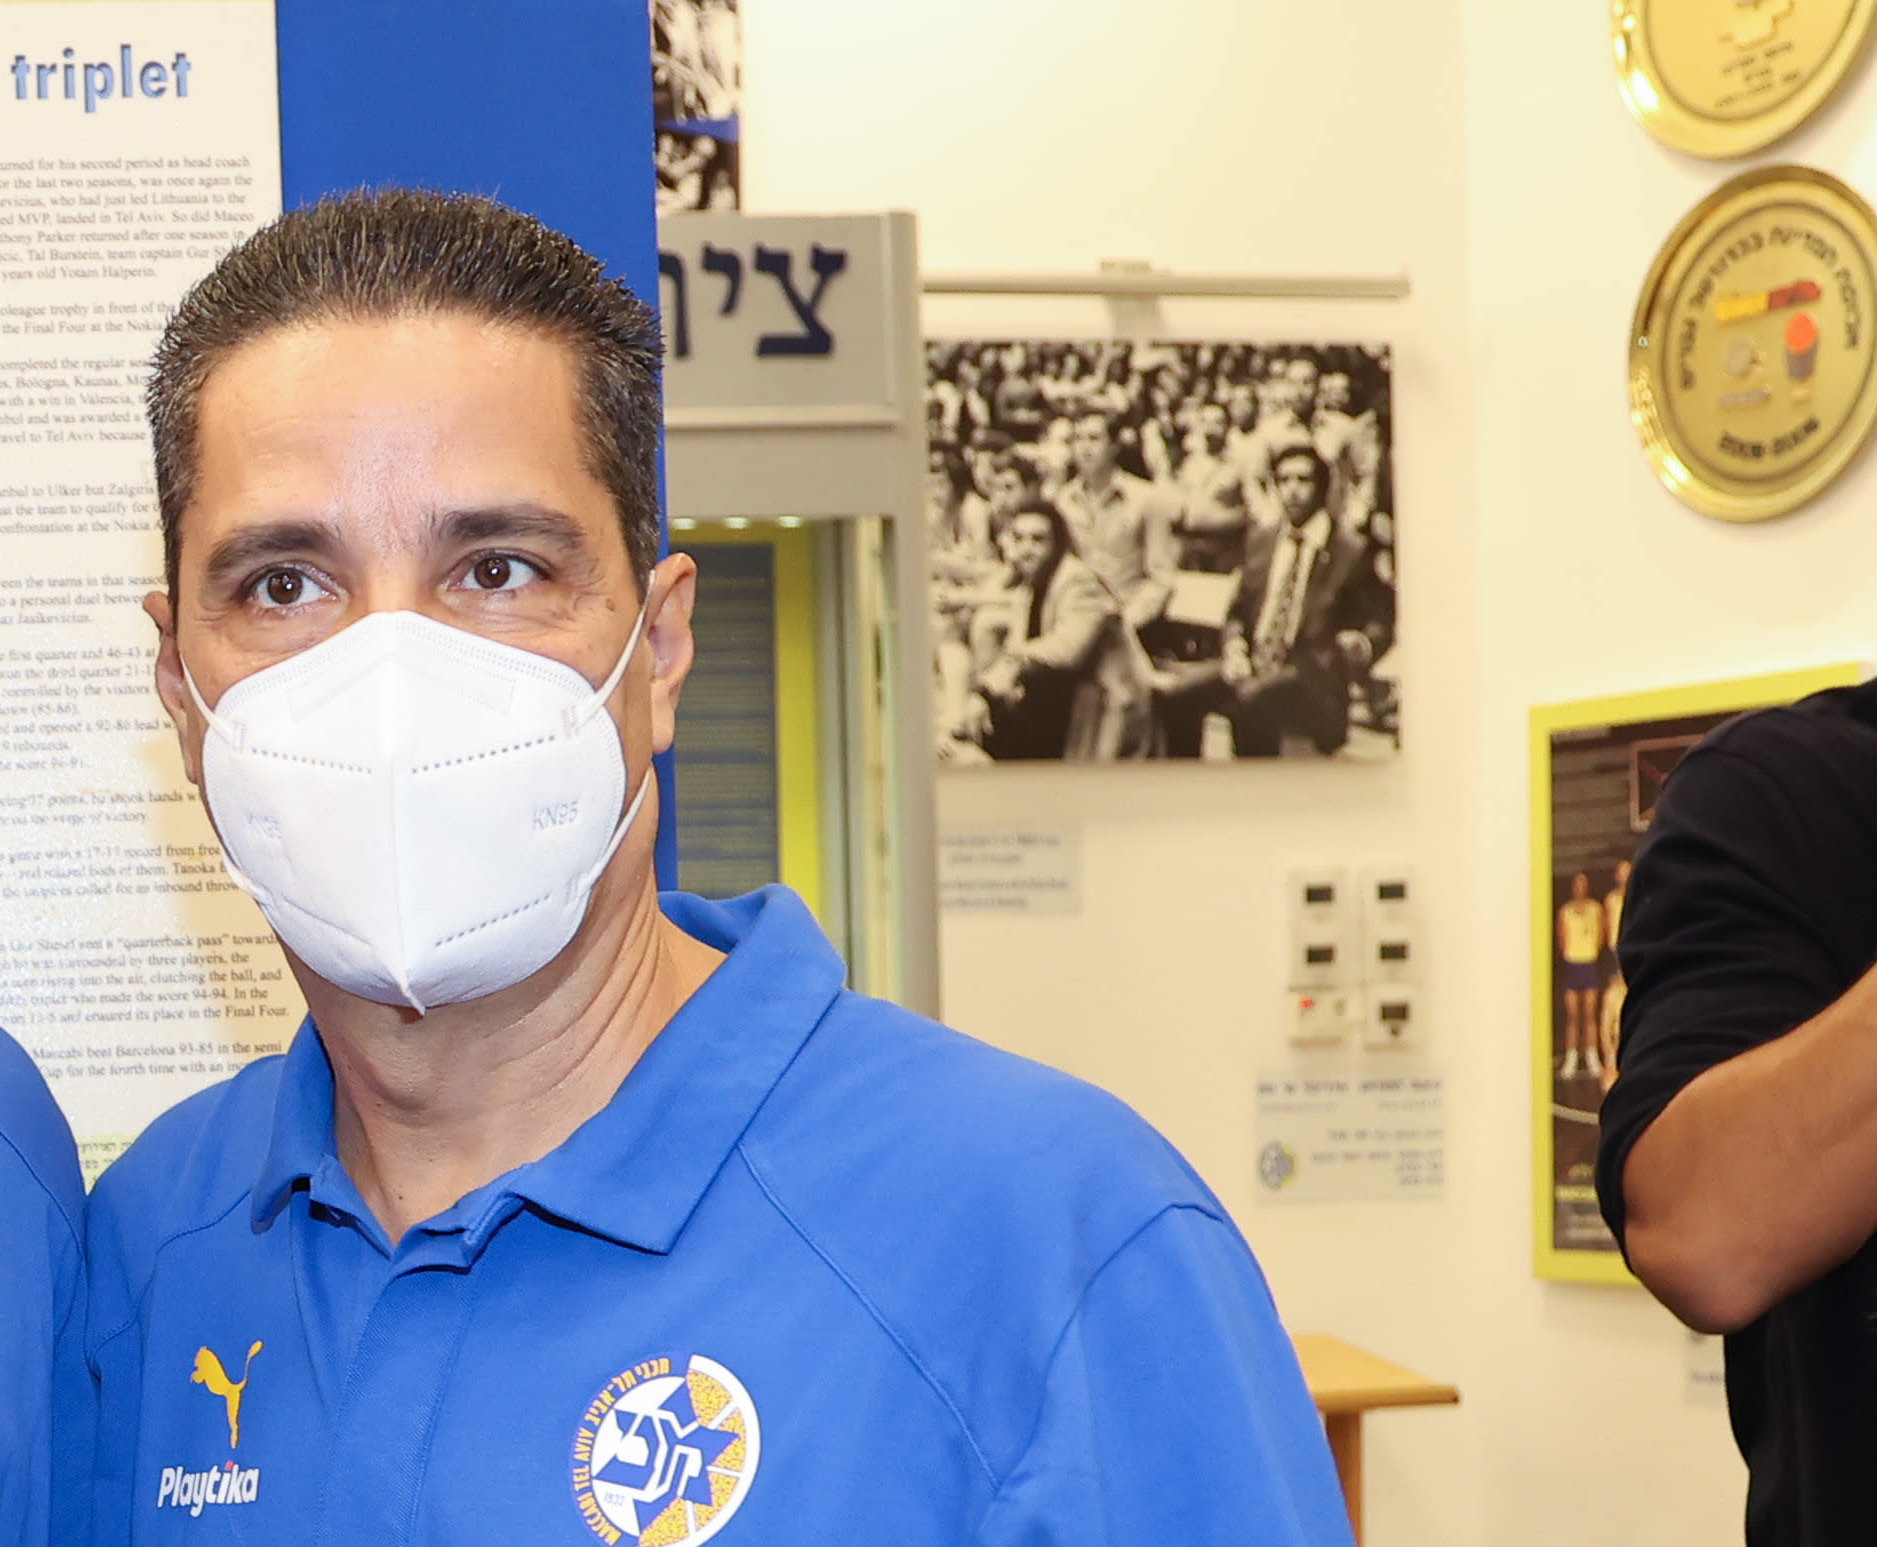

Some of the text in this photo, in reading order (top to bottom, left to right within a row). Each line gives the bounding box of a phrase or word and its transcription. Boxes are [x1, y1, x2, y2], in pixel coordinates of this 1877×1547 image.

[11, 44, 192, 113] triplet
[36, 159, 55, 171] for
[57, 158, 77, 170] his
[79, 157, 122, 170] second
[124, 157, 164, 172] period
[166, 159, 180, 168] as
[182, 156, 212, 168] head
[214, 155, 250, 167] coach
[12, 177, 33, 189] the
[34, 177, 58, 189] last
[58, 176, 84, 188] two
[138, 178, 164, 187] was
[165, 177, 195, 186] once
[197, 174, 232, 189] again
[233, 173, 253, 185] the
[48, 195, 76, 207] who
[78, 194, 102, 206] had
[103, 194, 126, 209] just
[128, 193, 148, 205] led
[150, 192, 210, 205] Lithuania
[211, 192, 225, 204] to
[226, 191, 246, 203] the
[55, 212, 96, 224] landed
[99, 212, 112, 224] in
[115, 211, 134, 223] Tel
[170, 210, 189, 222] So
[190, 210, 211, 222] did
[36, 231, 76, 243] Parker
[78, 229, 130, 242] returned
[132, 229, 160, 241] after
[163, 231, 186, 240] one
[188, 230, 229, 240] season
[27, 249, 46, 261] Tal
[105, 248, 137, 260] team
[138, 247, 184, 262] captain
[0, 271, 34, 283] years
[36, 267, 57, 279] old
[105, 968, 282, 987] the air, clutching the ball, and
[187, 1004, 290, 1019] in the Final Four.
[114, 1041, 282, 1057] Barcelona 93-85 in the semi
[157, 1460, 260, 1518] Playtika
[572, 1427, 622, 1546] MACCABI TEL AVIV
